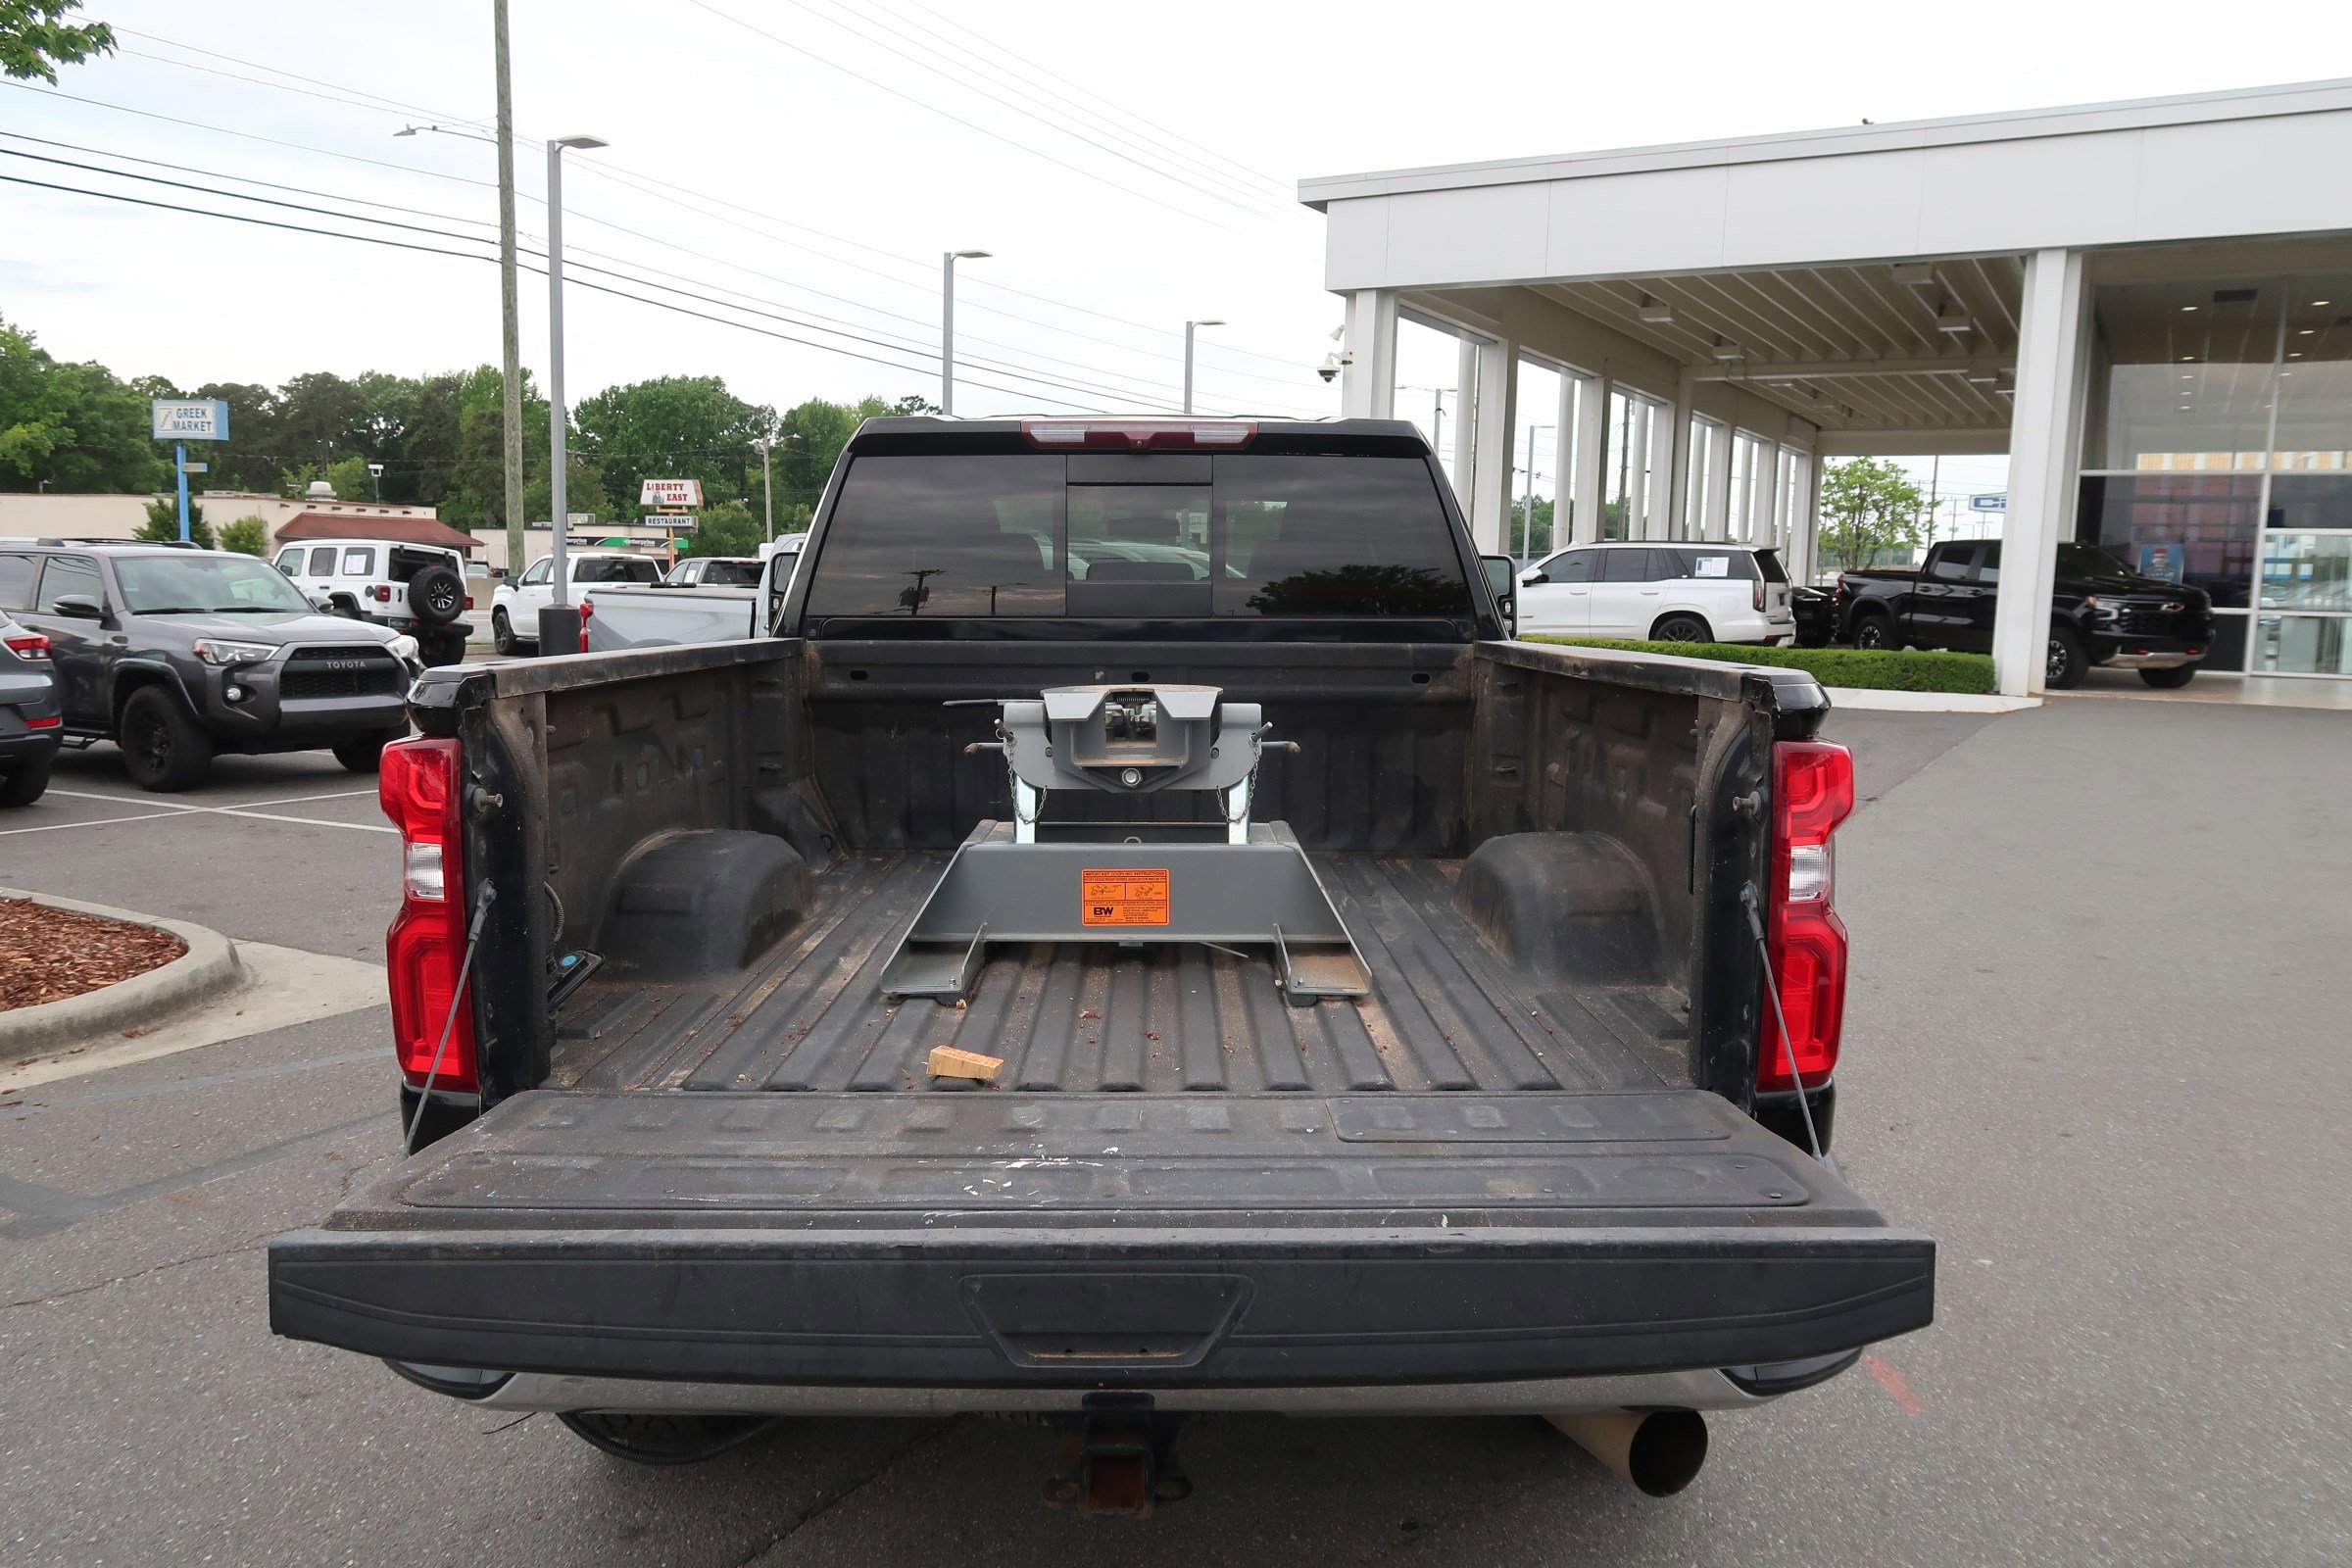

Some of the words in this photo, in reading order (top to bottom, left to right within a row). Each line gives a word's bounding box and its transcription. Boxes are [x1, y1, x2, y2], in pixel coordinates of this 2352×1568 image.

[176, 408, 208, 418] GREEK
[172, 420, 212, 431] MARKET
[646, 482, 684, 491] LIBERTY
[666, 493, 688, 502] EAST
